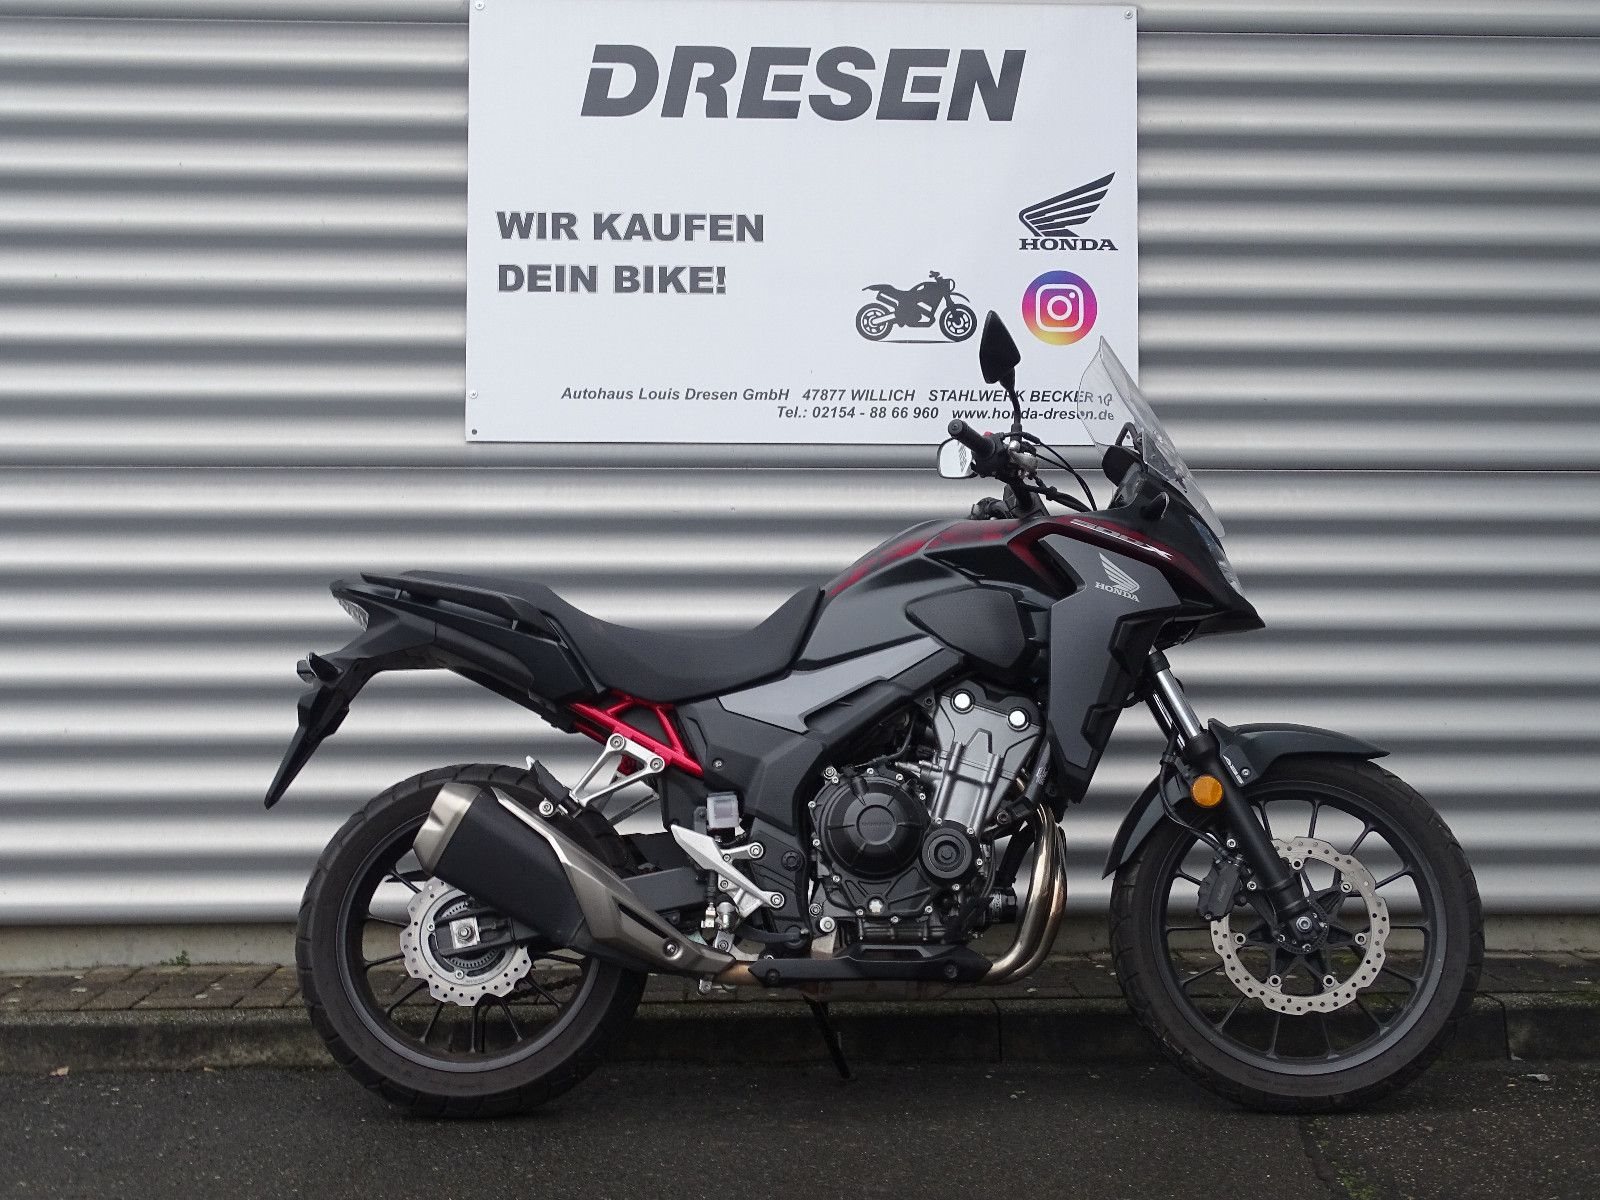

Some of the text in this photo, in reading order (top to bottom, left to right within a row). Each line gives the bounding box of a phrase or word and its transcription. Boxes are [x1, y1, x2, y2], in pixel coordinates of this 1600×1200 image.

[581, 44, 1026, 122] DRESEN
[497, 211, 764, 243] WIR KAUFEN
[1019, 237, 1118, 251] HONDA
[498, 264, 727, 295] DEIN BIKE!
[561, 387, 634, 400] Autohaus
[639, 388, 680, 401] Louis
[685, 388, 738, 401] Dresen
[743, 388, 790, 401] GmbH
[802, 389, 846, 401] 47877
[851, 389, 916, 402] WILLICH
[1029, 390, 1094, 403] BECKER
[777, 405, 808, 419] Tel.:
[812, 406, 856, 419] 02154
[869, 407, 887, 419] 88
[891, 407, 909, 419] 66
[912, 407, 939, 420] 960
[1095, 580, 1140, 603] HONDA
